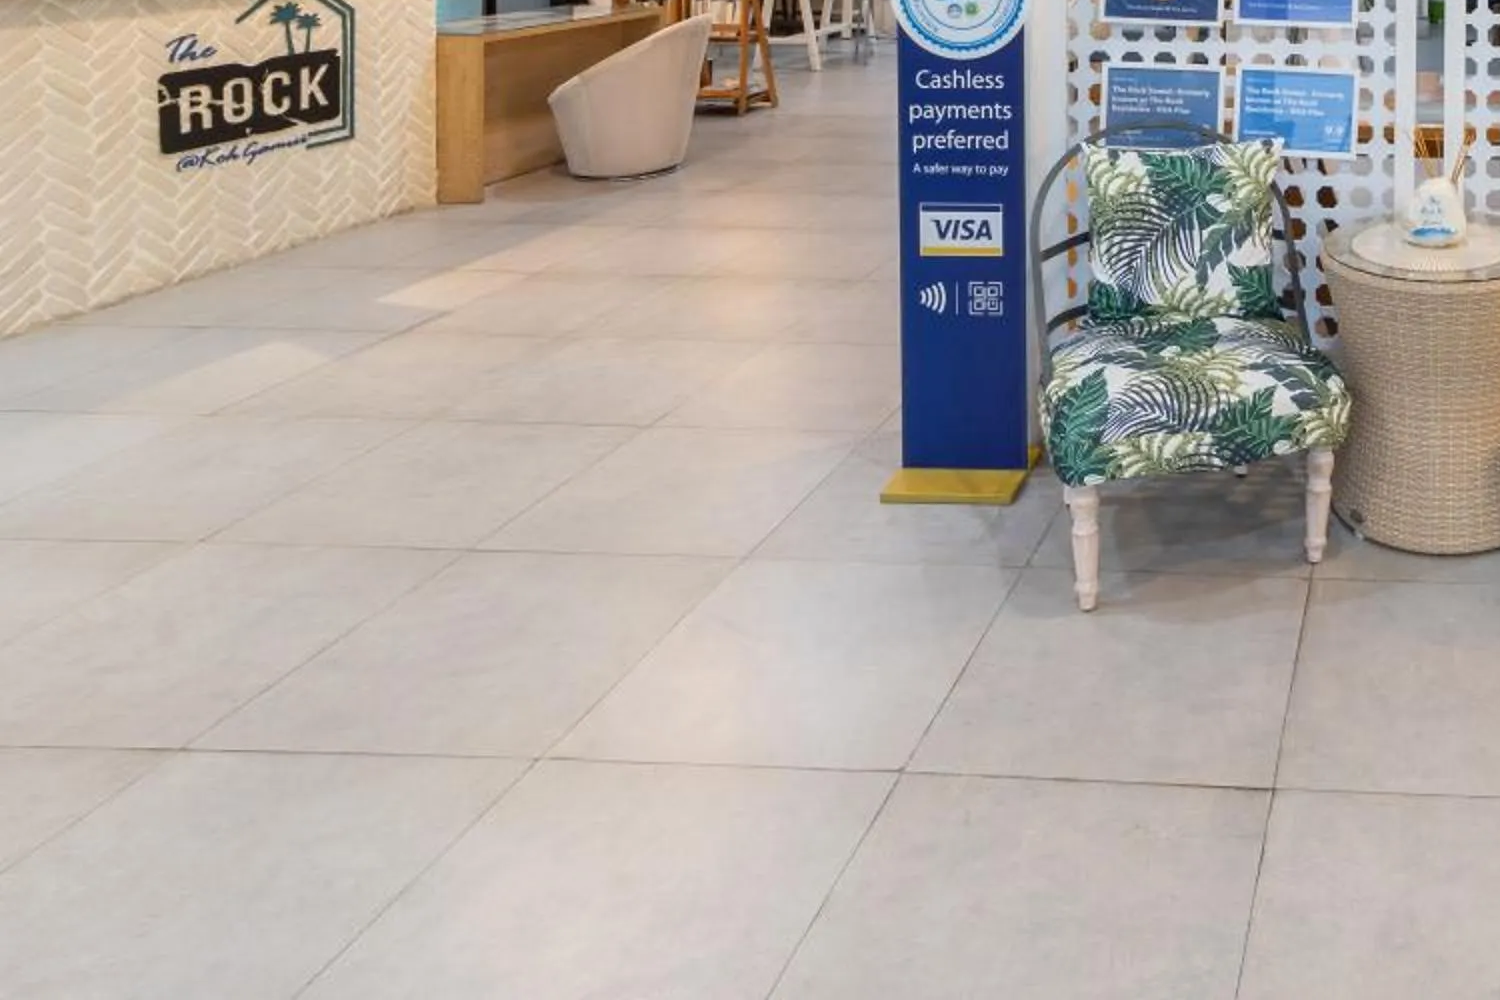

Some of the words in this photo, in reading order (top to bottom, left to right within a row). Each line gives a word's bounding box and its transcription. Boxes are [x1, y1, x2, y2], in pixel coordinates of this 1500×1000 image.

[165, 33, 218, 63] The
[915, 69, 1005, 89] Cashless
[179, 63, 329, 135] ROCK
[909, 103, 1012, 124] payments
[912, 129, 1009, 154] preferred
[912, 163, 921, 173] A
[923, 163, 949, 173] safer
[951, 165, 973, 176] way
[975, 165, 986, 174] to
[989, 165, 1009, 176] pay
[930, 219, 993, 240] VISA
